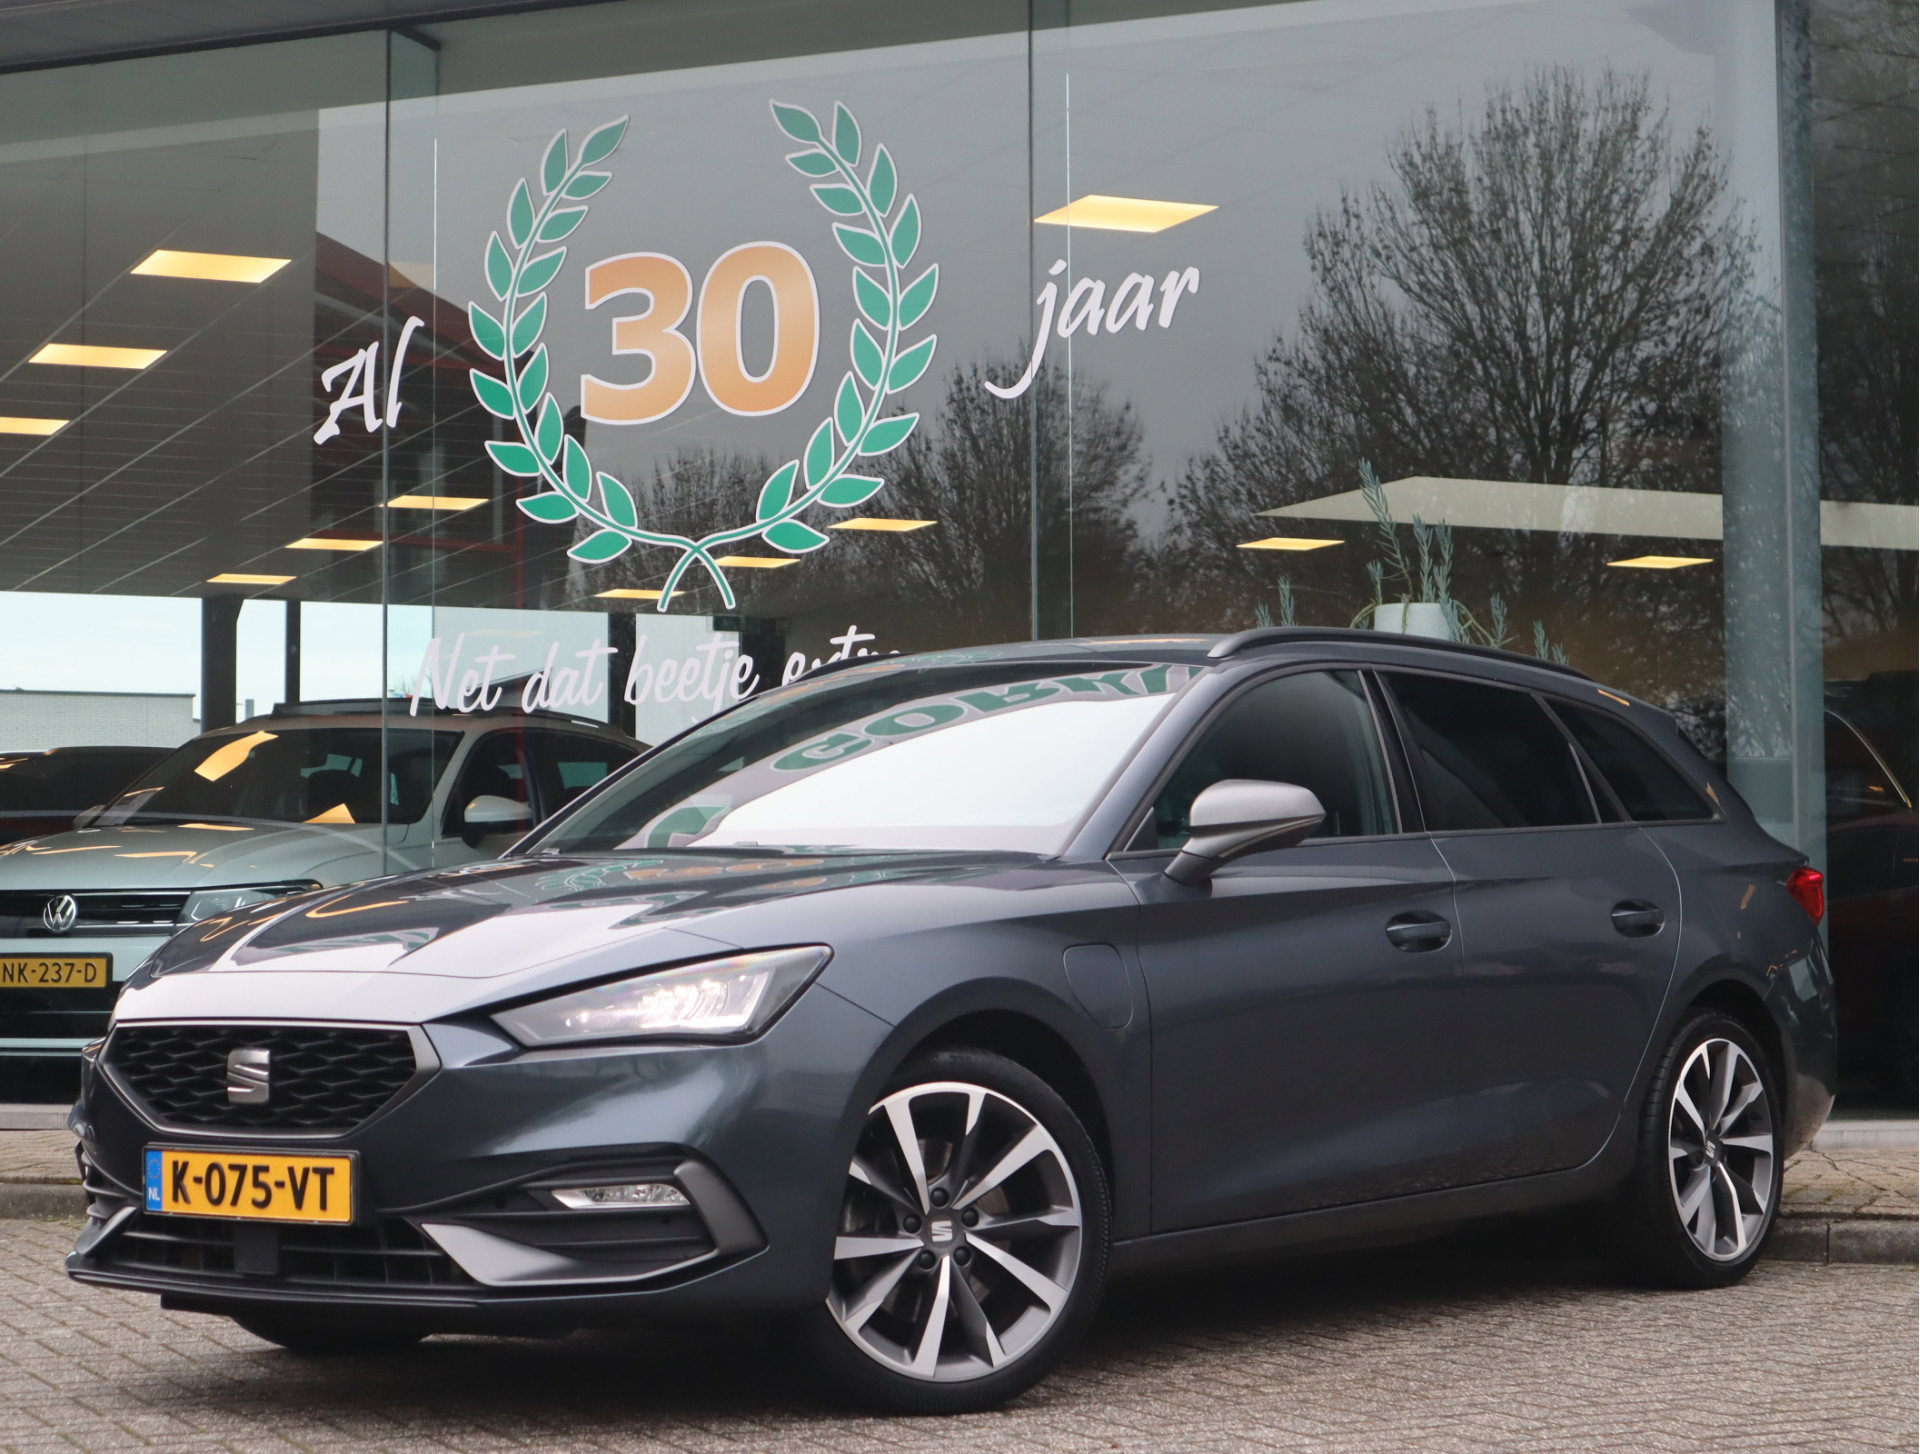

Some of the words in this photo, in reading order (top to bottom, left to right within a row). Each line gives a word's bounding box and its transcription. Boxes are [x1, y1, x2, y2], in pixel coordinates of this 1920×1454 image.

[313, 316, 425, 445] Al
[580, 241, 820, 424] 30
[984, 259, 1200, 400] jaar
[409, 633, 519, 716] Net
[522, 642, 618, 710] dat
[624, 635, 761, 712] beetje
[2, 962, 98, 984] NK-237-D
[148, 1187, 161, 1202] NL
[171, 1160, 334, 1211] K-075-VT
